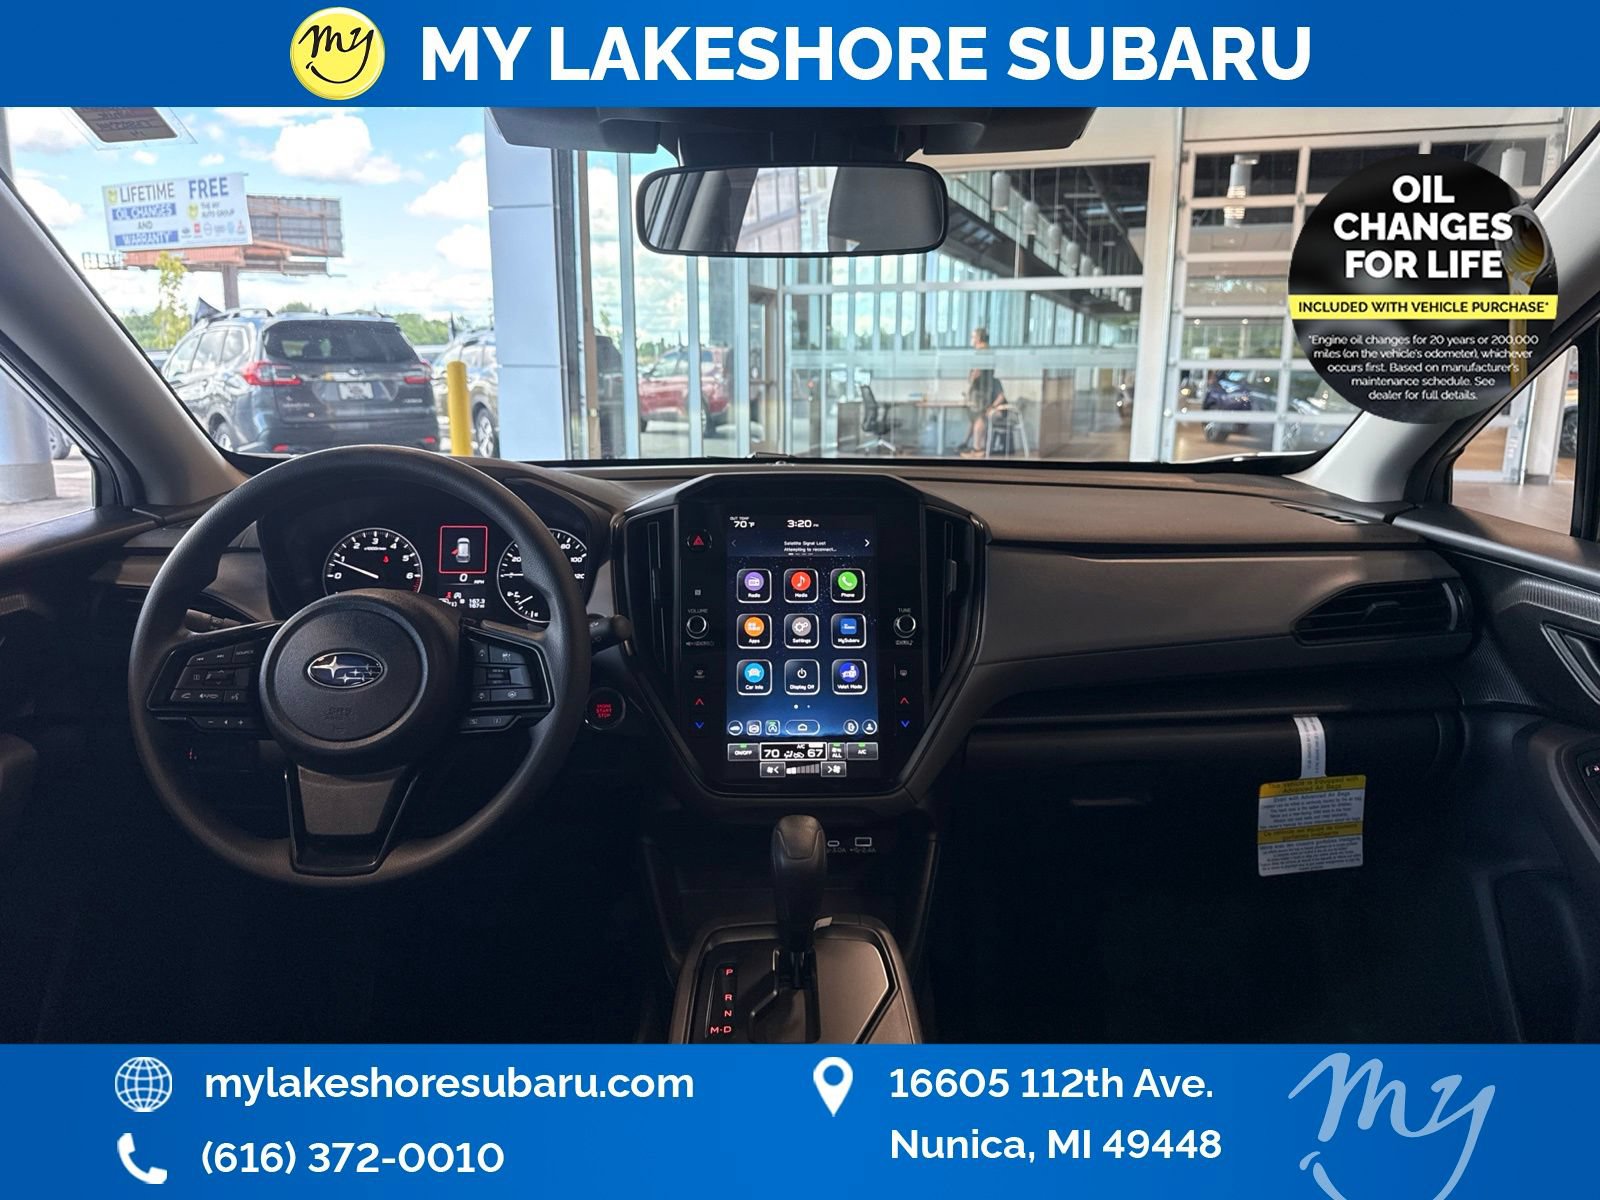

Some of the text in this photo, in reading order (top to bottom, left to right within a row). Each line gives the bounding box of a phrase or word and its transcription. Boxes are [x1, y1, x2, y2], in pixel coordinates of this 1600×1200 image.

[119, 181, 175, 204] LIFETIME
[188, 176, 229, 200] FREE
[115, 203, 173, 220] OIL CHANGES
[138, 220, 153, 230] AND
[123, 231, 170, 245] WARRANTY
[733, 520, 748, 528] 70
[787, 519, 812, 528] 3:20
[340, 555, 346, 563] 1
[402, 554, 410, 562] 5
[459, 573, 468, 582] 0
[763, 749, 780, 758] 70
[807, 749, 823, 758] 67
[725, 968, 734, 976] P
[724, 993, 733, 1001] R
